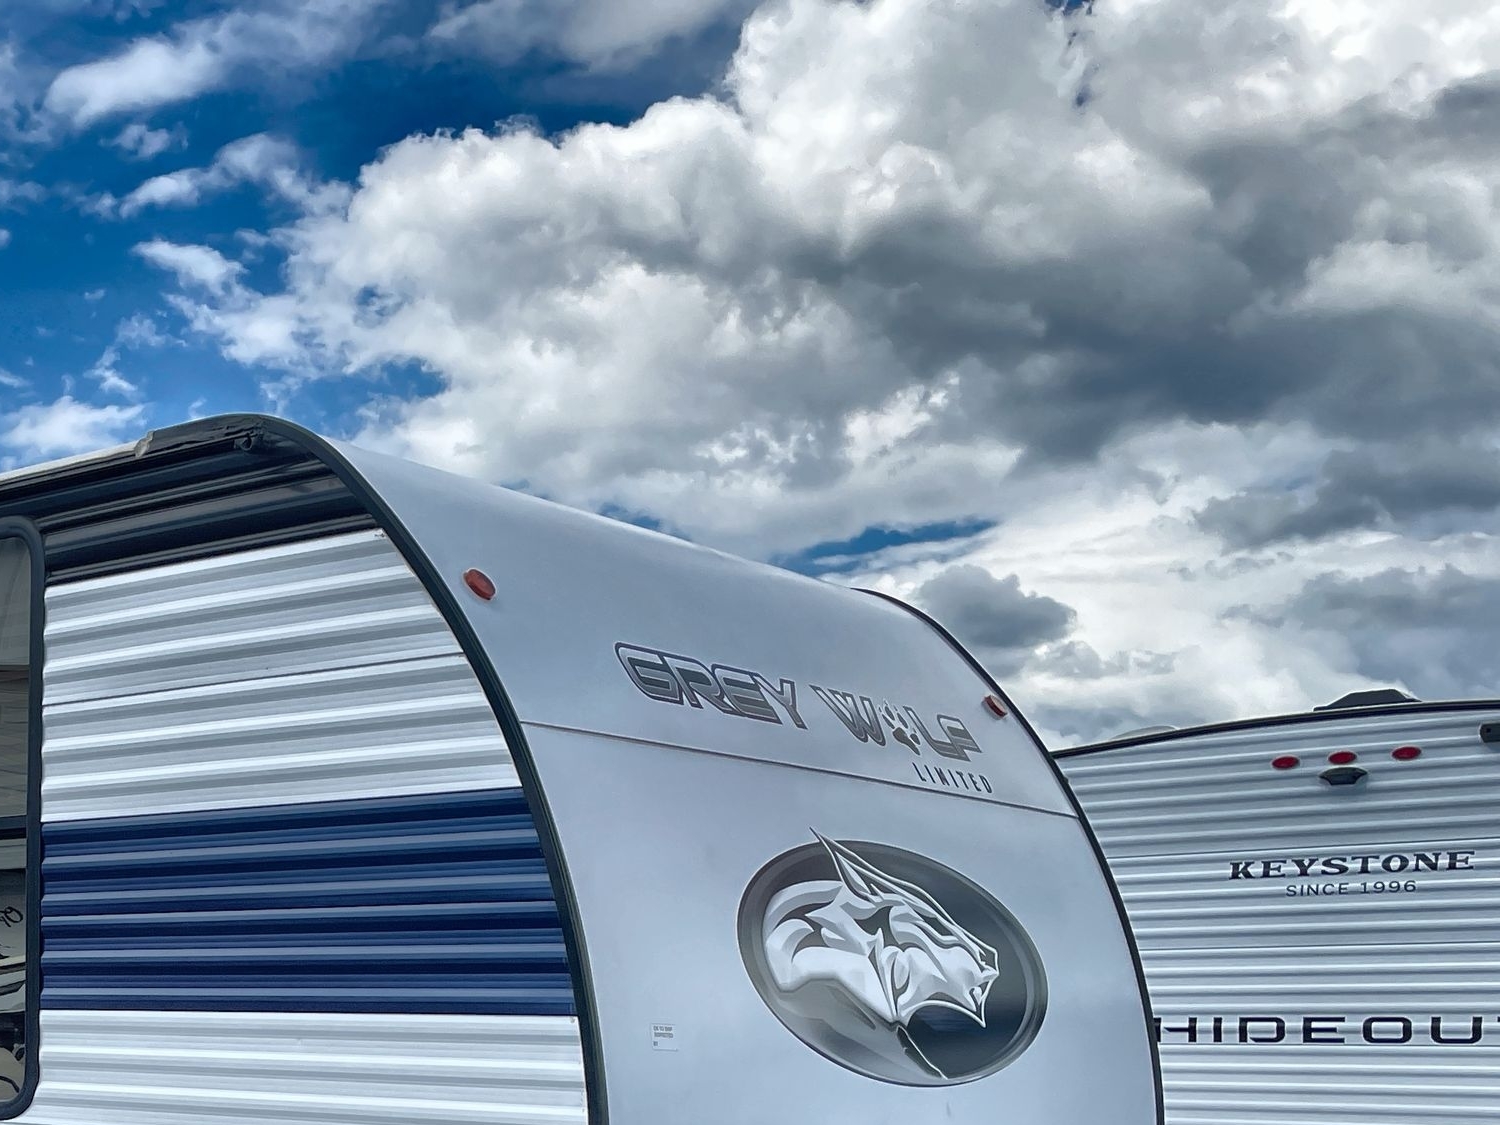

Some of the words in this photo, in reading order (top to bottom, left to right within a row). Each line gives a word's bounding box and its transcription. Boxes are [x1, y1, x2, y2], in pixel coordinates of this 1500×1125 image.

[614, 642, 808, 729] GREY
[912, 761, 993, 795] LIMITED
[1229, 850, 1476, 881] KEYSTONE
[1285, 882, 1349, 898] SINCE
[1360, 880, 1417, 894] 1996
[1152, 1016, 1500, 1044] HIDEOU
